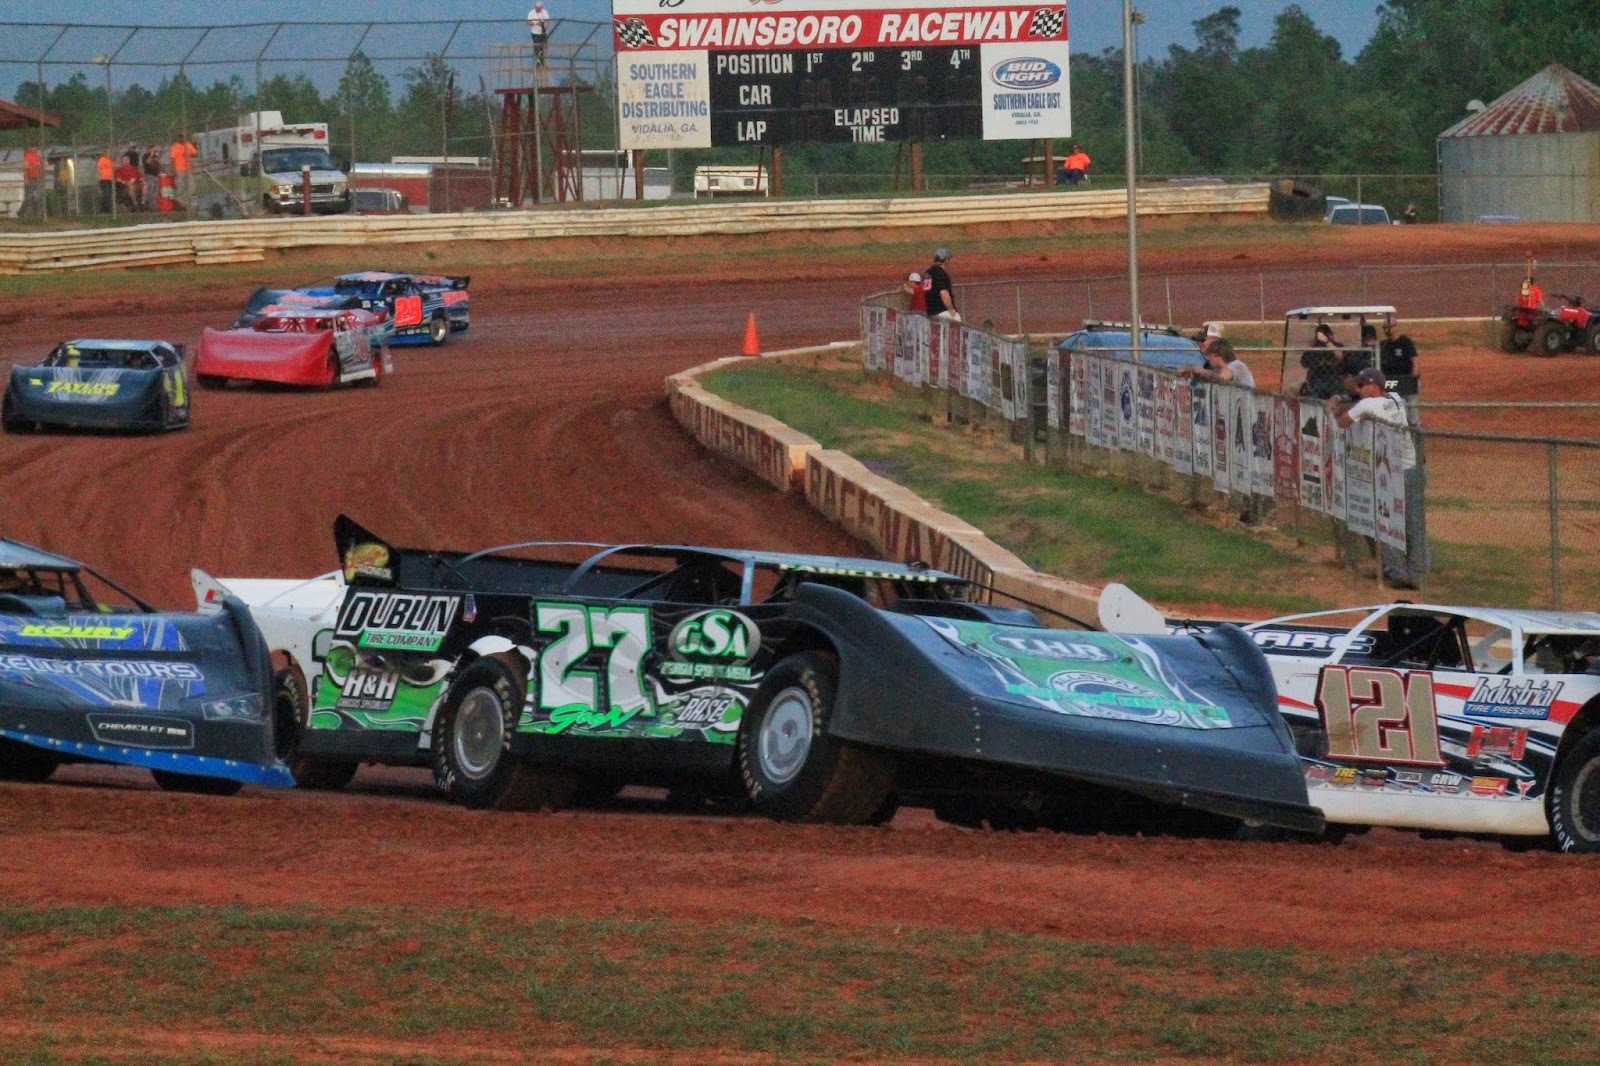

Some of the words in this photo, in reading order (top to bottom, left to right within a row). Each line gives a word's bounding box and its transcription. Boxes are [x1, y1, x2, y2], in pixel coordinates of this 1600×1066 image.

[656, 15, 862, 48] SWAINSBORO
[878, 11, 1031, 43] RACEWAY
[717, 54, 793, 75] POSITION
[806, 53, 823, 73] 1ST
[851, 52, 875, 72] 2ND
[901, 50, 922, 70] 3RD
[950, 49, 970, 69] 4TH
[1007, 62, 1047, 72] BUD
[630, 63, 697, 81] SOUTHERN
[999, 71, 1053, 82] LIGHT
[645, 83, 684, 99] EAGLE
[739, 85, 772, 105] CAR
[622, 100, 708, 119] DISTRIBUTING
[993, 93, 1027, 110] SOUTHERN
[1027, 93, 1046, 109] EAGLE
[834, 108, 899, 126] ELAPSED
[737, 121, 767, 141] LAP
[850, 125, 885, 143] TIME
[809, 456, 946, 571] RACEWAY
[336, 592, 460, 636] DUBLIN
[365, 633, 385, 644] TIRE
[386, 634, 439, 647] COMPANY
[677, 609, 748, 657] GSA
[537, 602, 656, 717] 27
[83, 661, 197, 679] TOURS
[342, 669, 400, 700] H&H
[1471, 677, 1565, 706] Industrial
[1315, 665, 1447, 767] 121
[1465, 704, 1490, 713] TIRE
[1492, 705, 1546, 716] PRESSING
[98, 722, 164, 733] CHEVROLET
